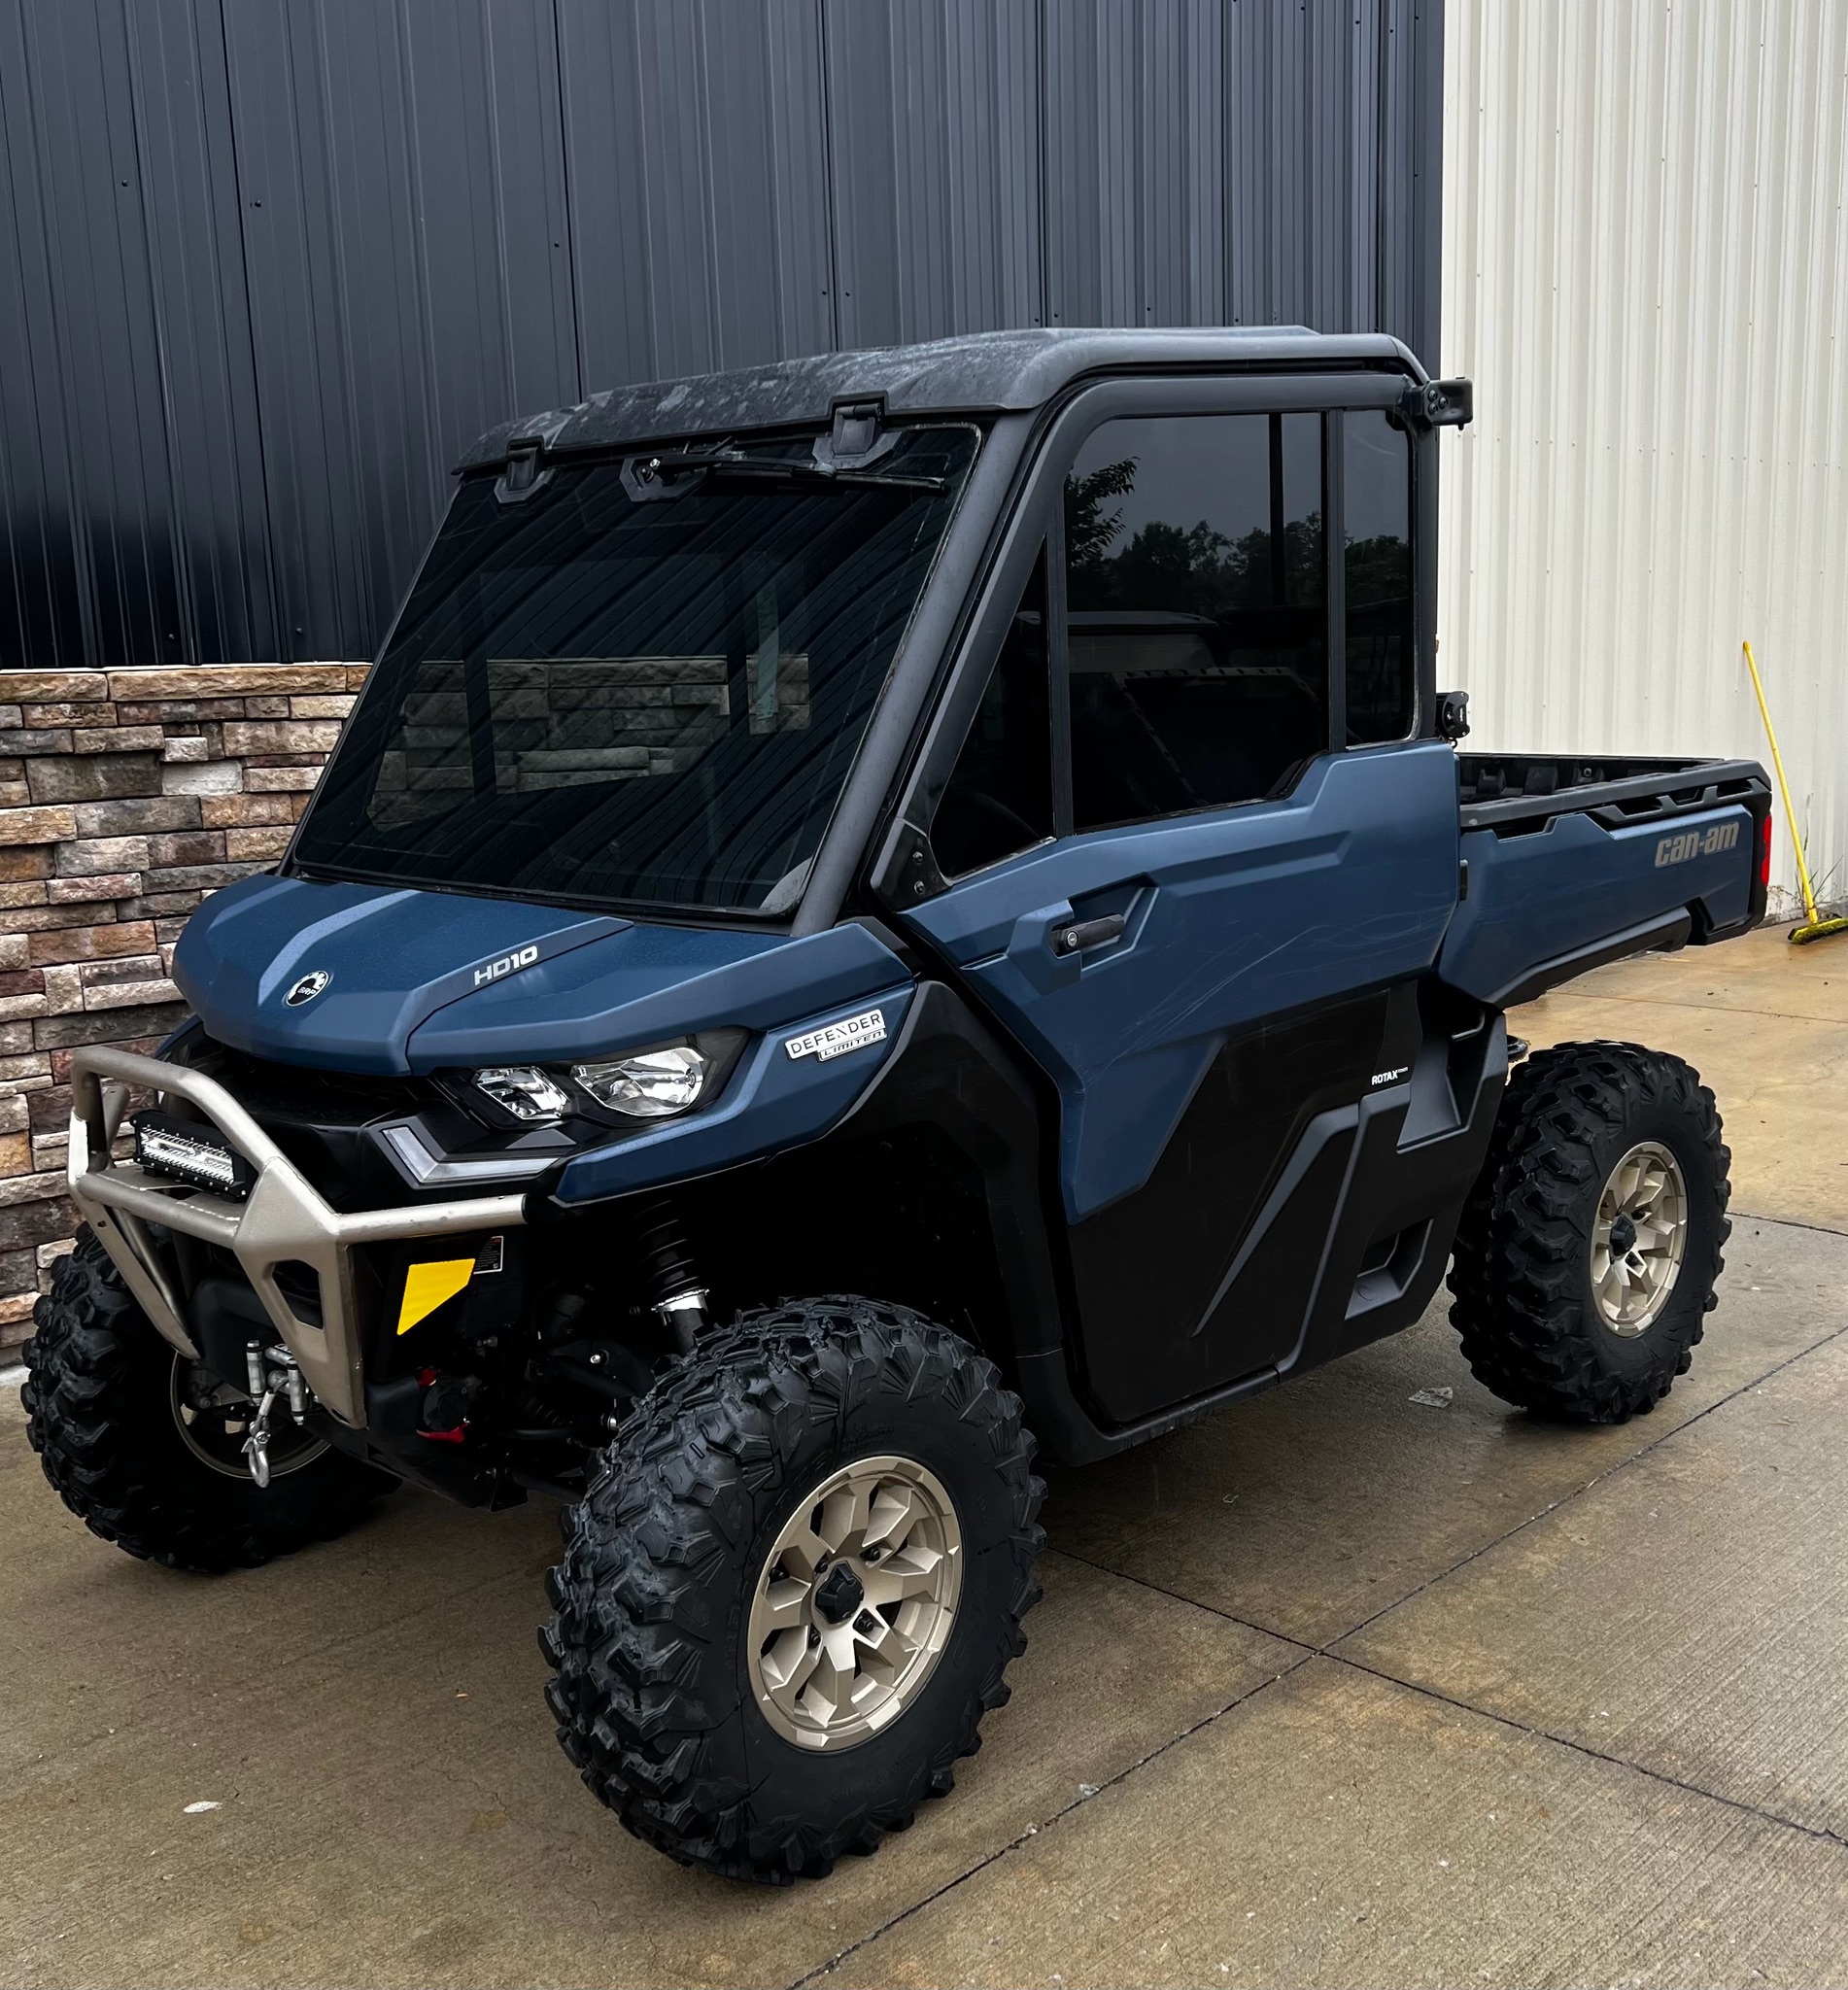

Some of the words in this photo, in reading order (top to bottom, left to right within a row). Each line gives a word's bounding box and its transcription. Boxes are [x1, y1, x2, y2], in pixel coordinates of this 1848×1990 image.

[1655, 821, 1739, 868] can-am
[474, 945, 537, 985] HD10
[790, 1013, 880, 1054] DEFENDER
[824, 1029, 882, 1056] LIMITED
[1371, 1069, 1398, 1085] ROTAX
